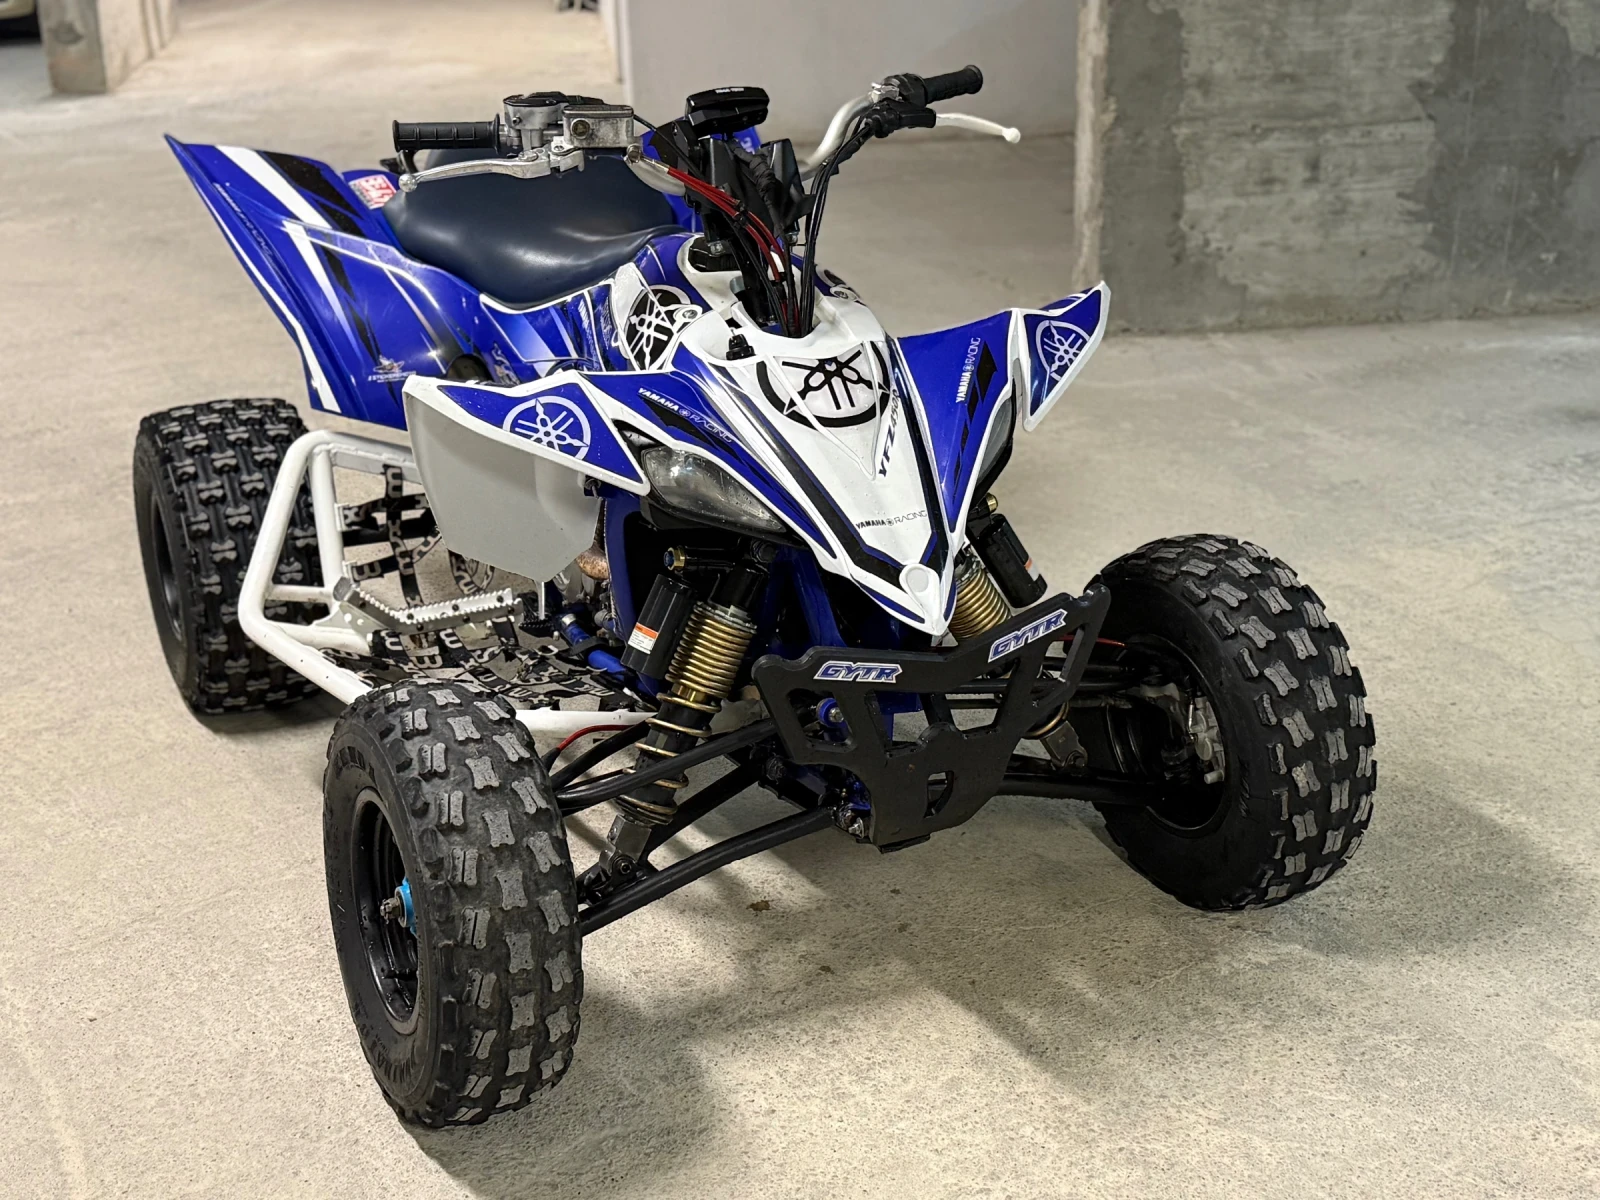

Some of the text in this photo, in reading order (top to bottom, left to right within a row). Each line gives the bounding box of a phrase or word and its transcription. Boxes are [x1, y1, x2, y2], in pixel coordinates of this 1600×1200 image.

[956, 371, 972, 403] YAMAHA
[638, 387, 732, 443] YAMAHA RACING
[855, 509, 928, 530] YAMAHA RACING
[987, 609, 1067, 661] GYTR
[814, 661, 902, 683] GYTR
